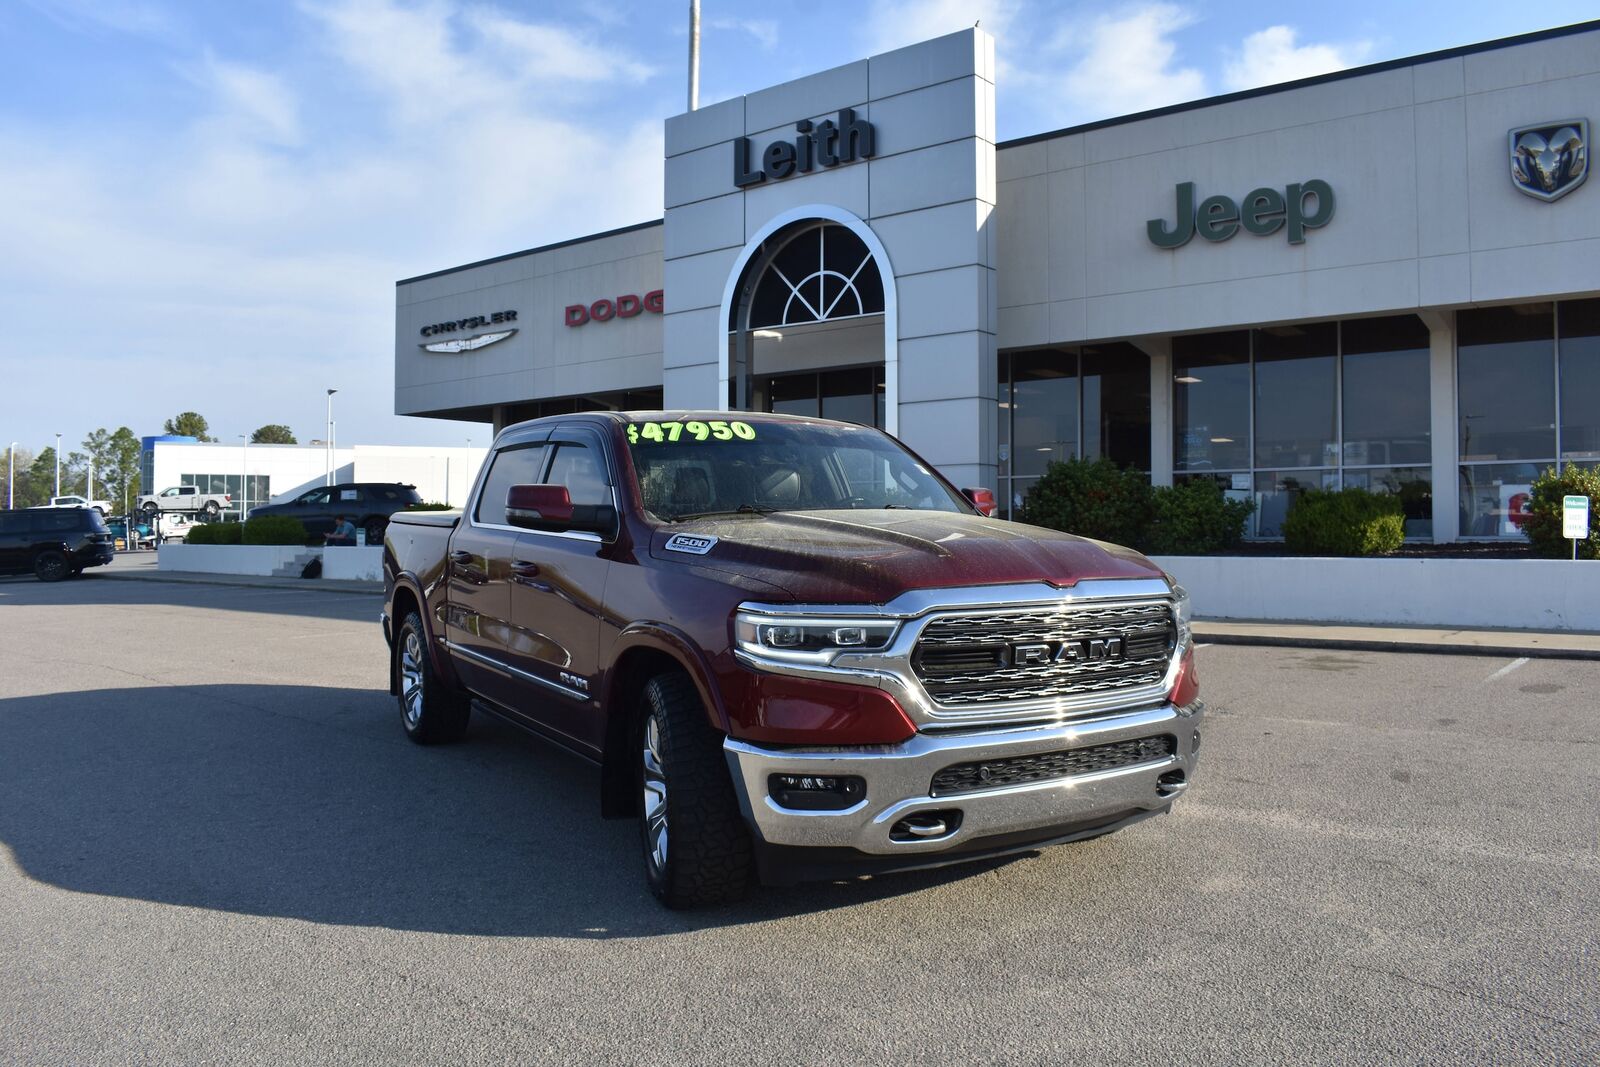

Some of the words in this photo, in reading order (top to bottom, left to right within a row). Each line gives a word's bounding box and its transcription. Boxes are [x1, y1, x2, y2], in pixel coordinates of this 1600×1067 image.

[734, 108, 876, 187] Leith
[1146, 179, 1336, 249] Jeep
[420, 309, 518, 337] CHRYSLER
[626, 421, 756, 444] $47950
[675, 536, 709, 548] 1500
[1015, 638, 1121, 665] RAM
[559, 671, 588, 690] RAM
